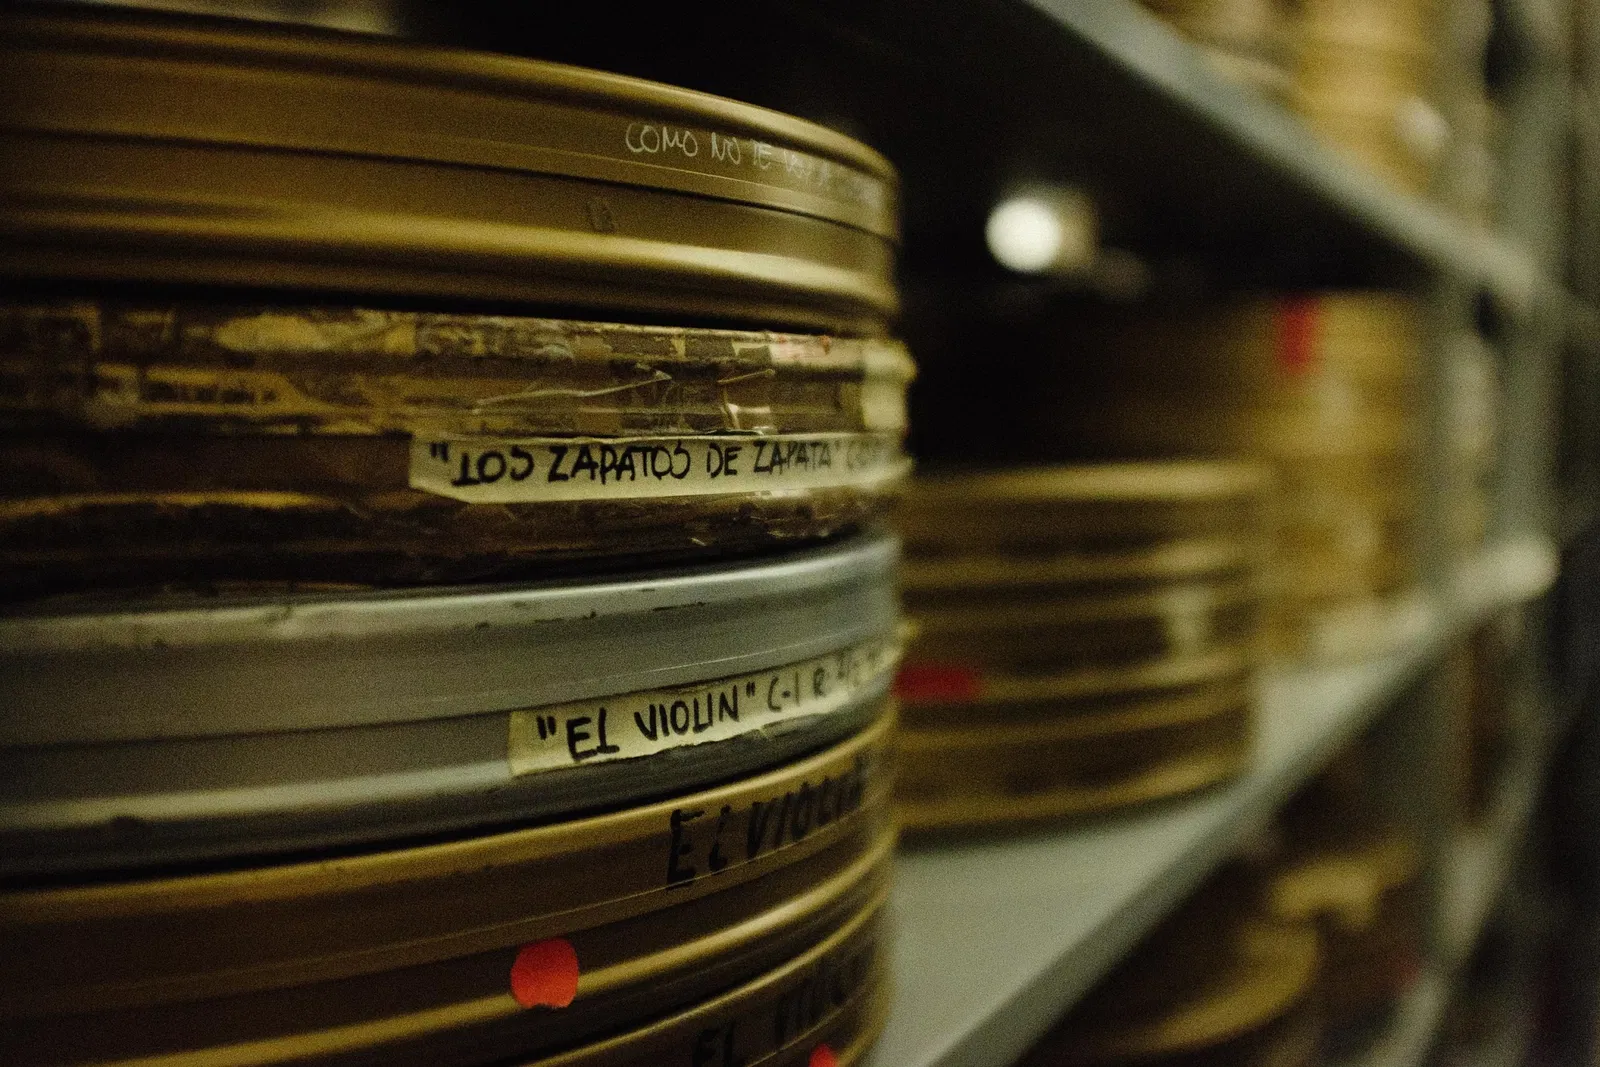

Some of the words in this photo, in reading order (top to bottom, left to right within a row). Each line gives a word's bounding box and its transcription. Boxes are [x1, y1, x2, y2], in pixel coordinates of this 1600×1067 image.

[625, 122, 698, 158] COMO
[711, 131, 742, 166] NO
[546, 440, 691, 485] ZAPATOS
[705, 442, 739, 478] DE
[537, 707, 620, 763] "EL
[634, 680, 757, 742] VIOLIN"
